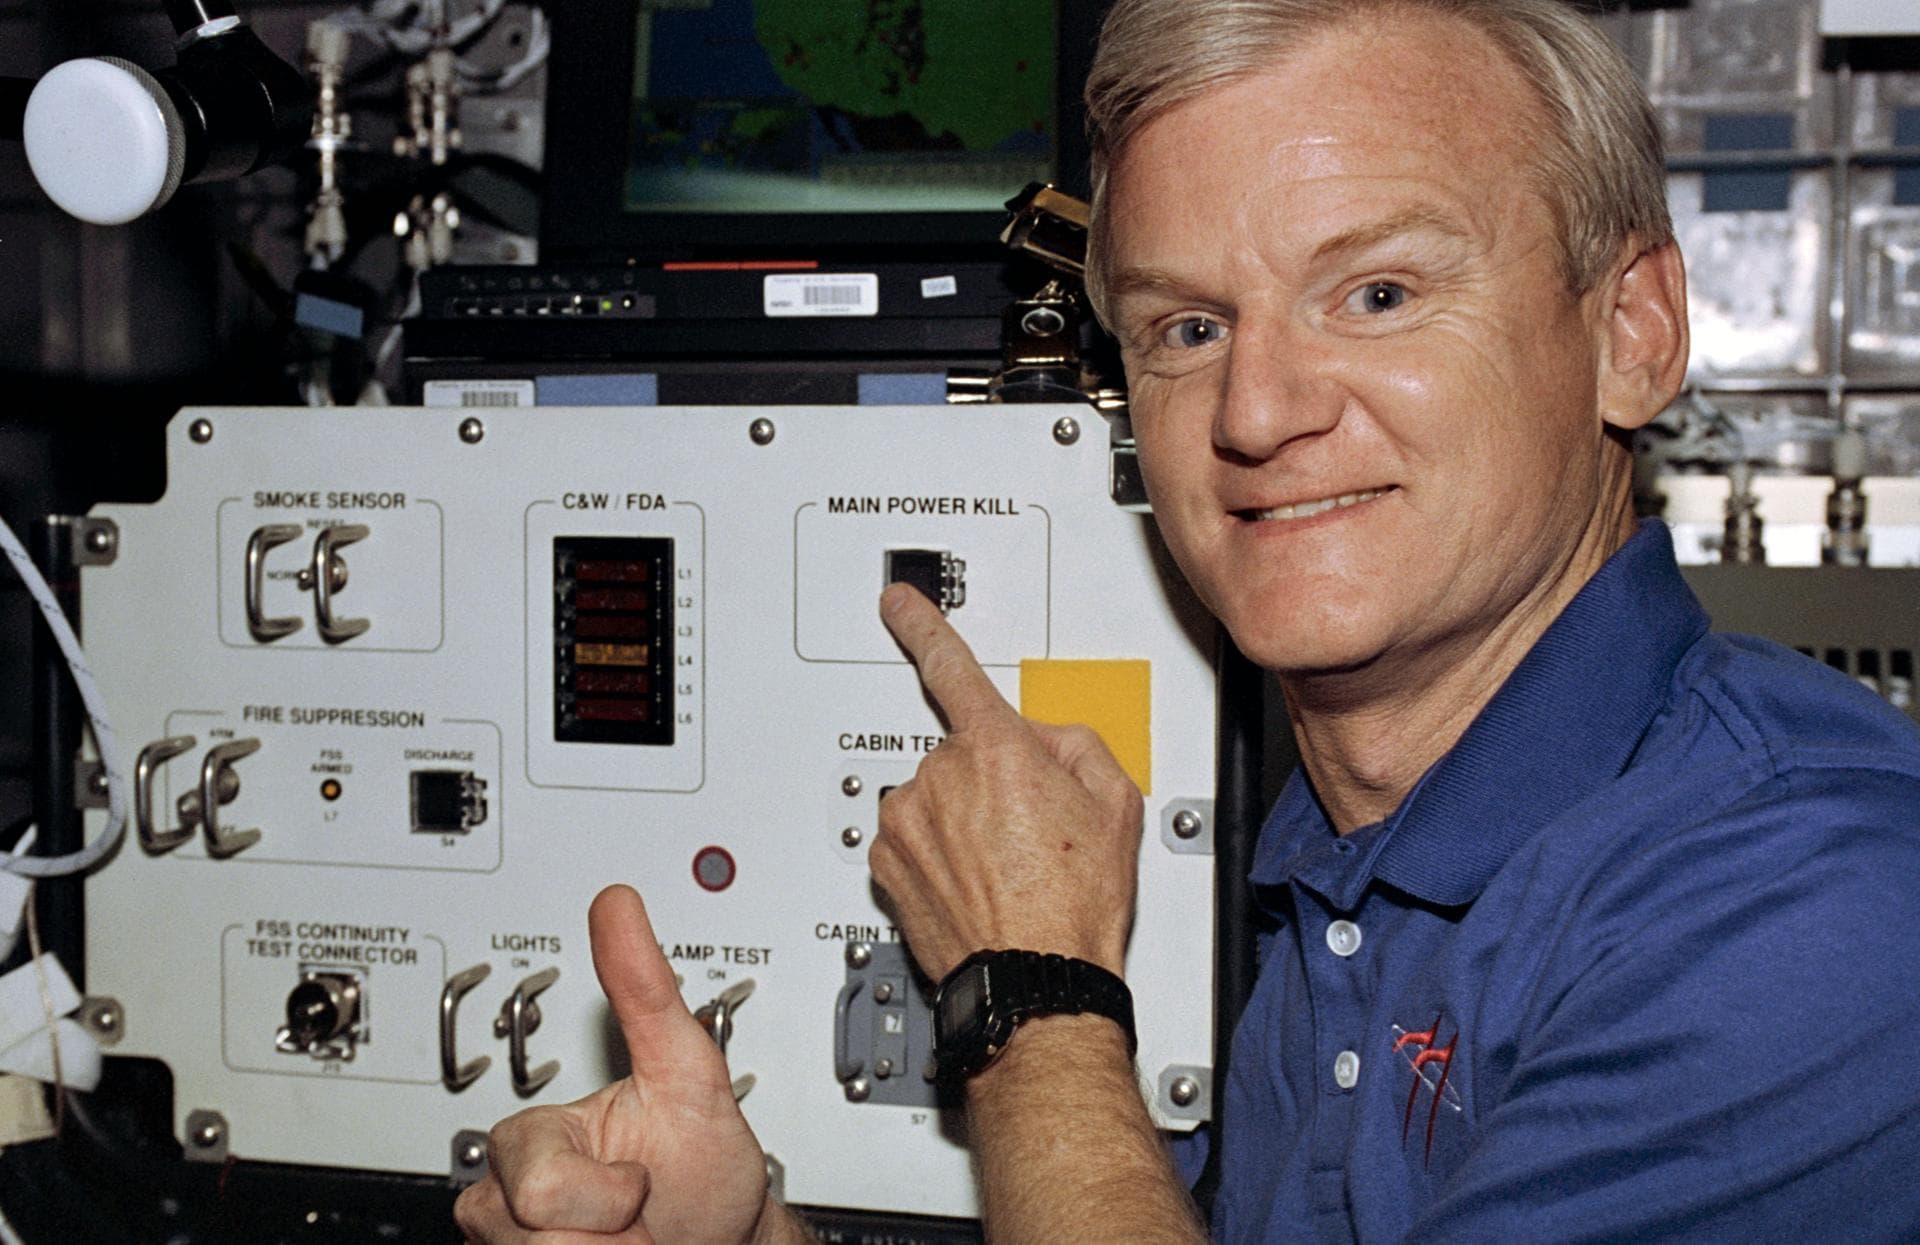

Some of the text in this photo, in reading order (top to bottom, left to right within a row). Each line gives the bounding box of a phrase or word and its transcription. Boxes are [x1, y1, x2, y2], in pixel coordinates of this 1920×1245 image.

[253, 491, 406, 510] SMOKE SENSOR
[562, 492, 610, 510] C&W
[626, 493, 667, 510] FDA
[828, 496, 1019, 515] MAIN POWER KILL
[678, 598, 693, 608] L2
[678, 656, 693, 666] L4
[243, 705, 425, 728] FIRE SUPPRESSION
[838, 733, 946, 752] CABIN TE
[404, 750, 474, 761] DISCHARGE
[255, 920, 410, 944] FSS CONTINUITY
[815, 923, 879, 942] CABIN
[246, 940, 418, 965] TEST CONNECTOR
[491, 934, 562, 953] LIGHTS
[722, 947, 772, 965] TEST
